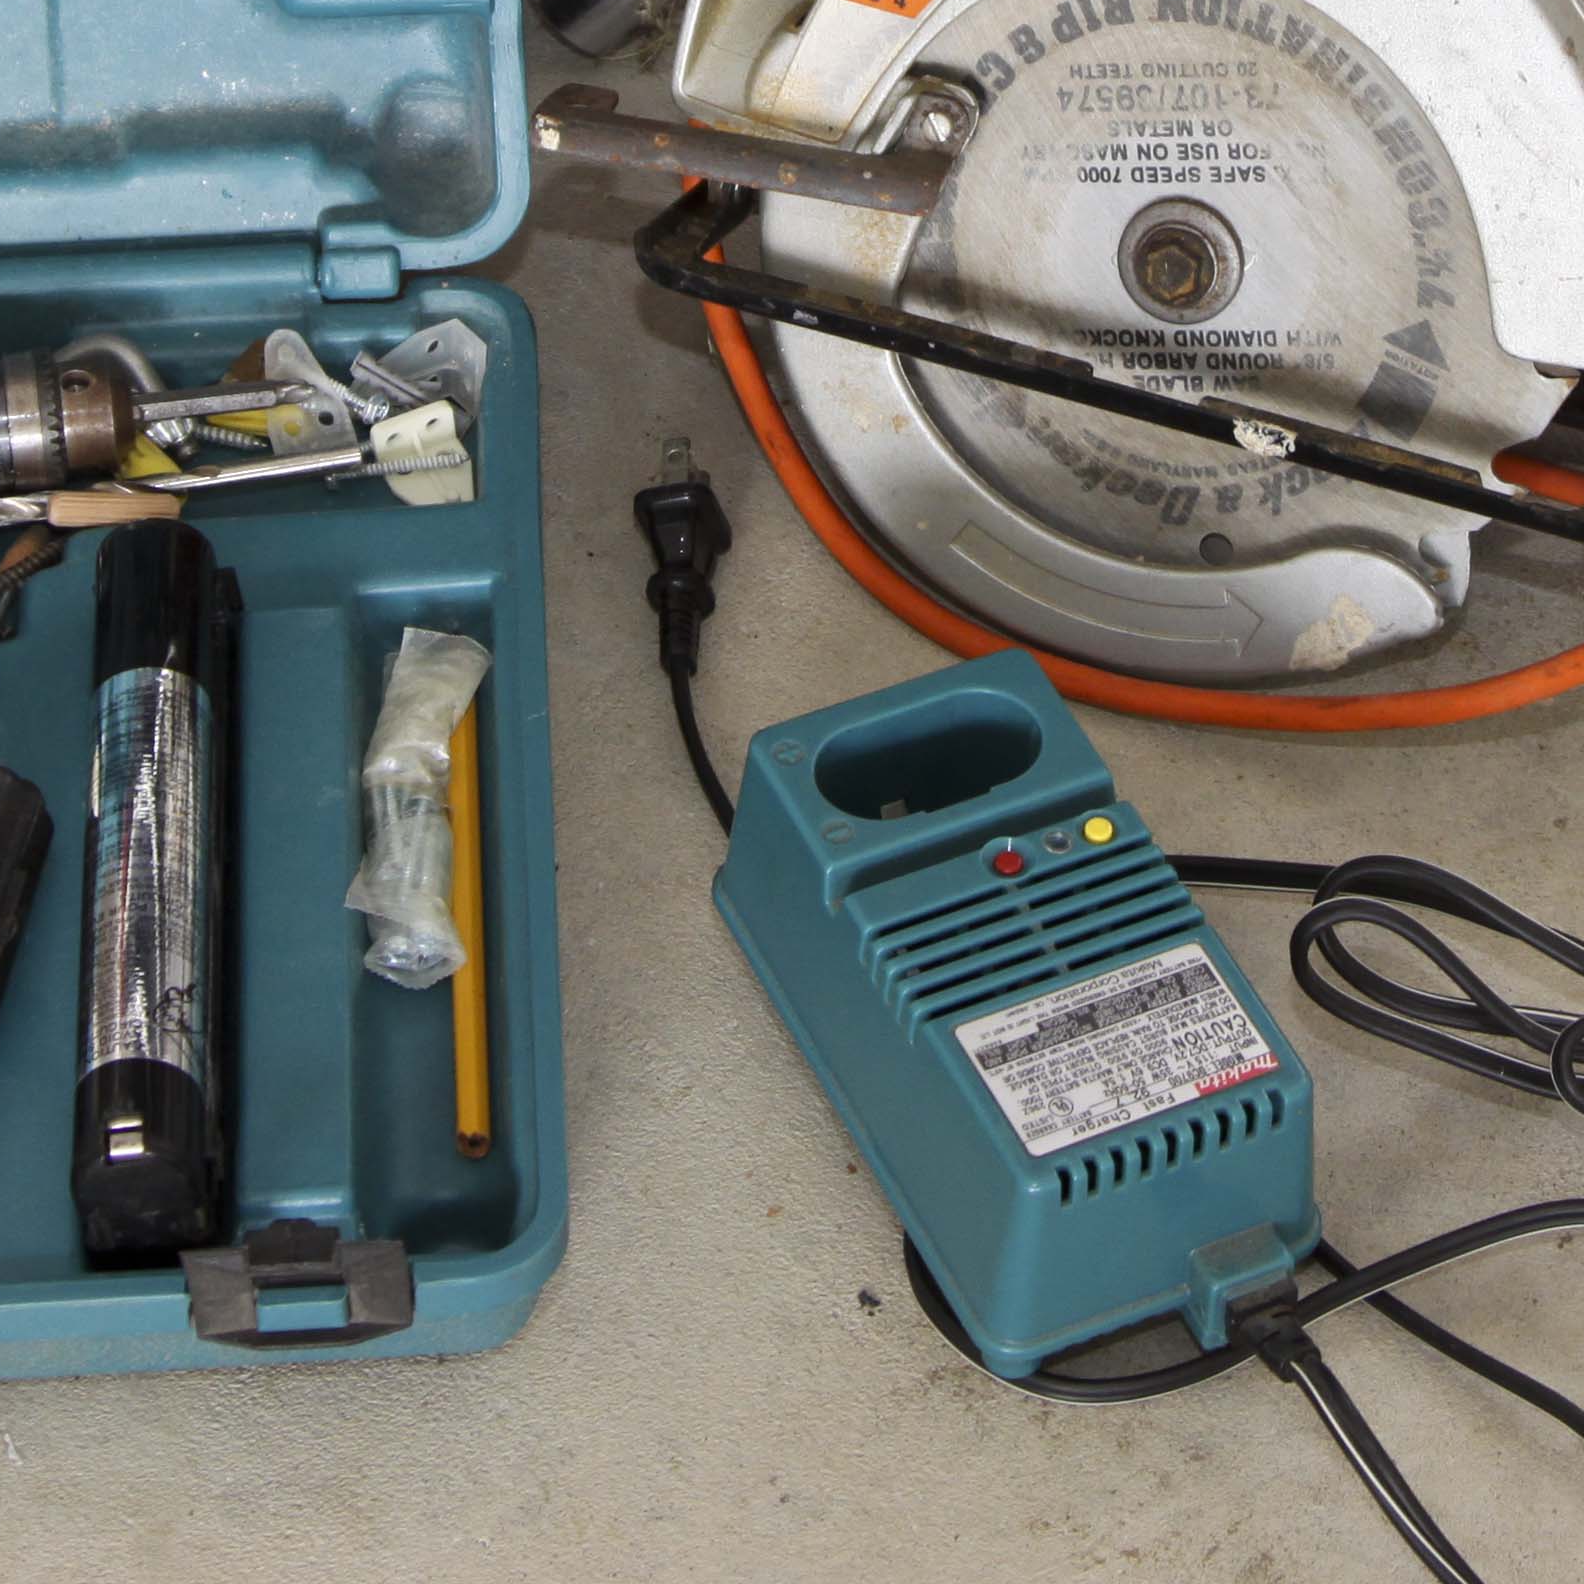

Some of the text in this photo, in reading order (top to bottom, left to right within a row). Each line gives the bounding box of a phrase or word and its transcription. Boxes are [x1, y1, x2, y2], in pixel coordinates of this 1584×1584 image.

[1008, 24, 1045, 64] &
[1069, 63, 1132, 78] TEETH
[1140, 62, 1228, 78] CUTTING
[1107, 120, 1232, 136] OR METALS
[1136, 144, 1168, 160] ON
[1176, 144, 1218, 160] USE
[1228, 144, 1271, 160] FOR
[1078, 166, 1122, 183] 7000
[1131, 166, 1200, 182] SPEED
[1209, 166, 1266, 182] SAFE
[1174, 330, 1276, 347] DIAMOND
[1287, 330, 1340, 347] WITH
[1122, 352, 1197, 369] ARBOR
[1202, 352, 1282, 369] ROUND
[1132, 376, 1259, 392] SAW BLADE
[1213, 484, 1243, 514] &
[1170, 1012, 1249, 1052] CAUTION
[1142, 1092, 1175, 1111] Fast
[1068, 1105, 1132, 1140] Charger
